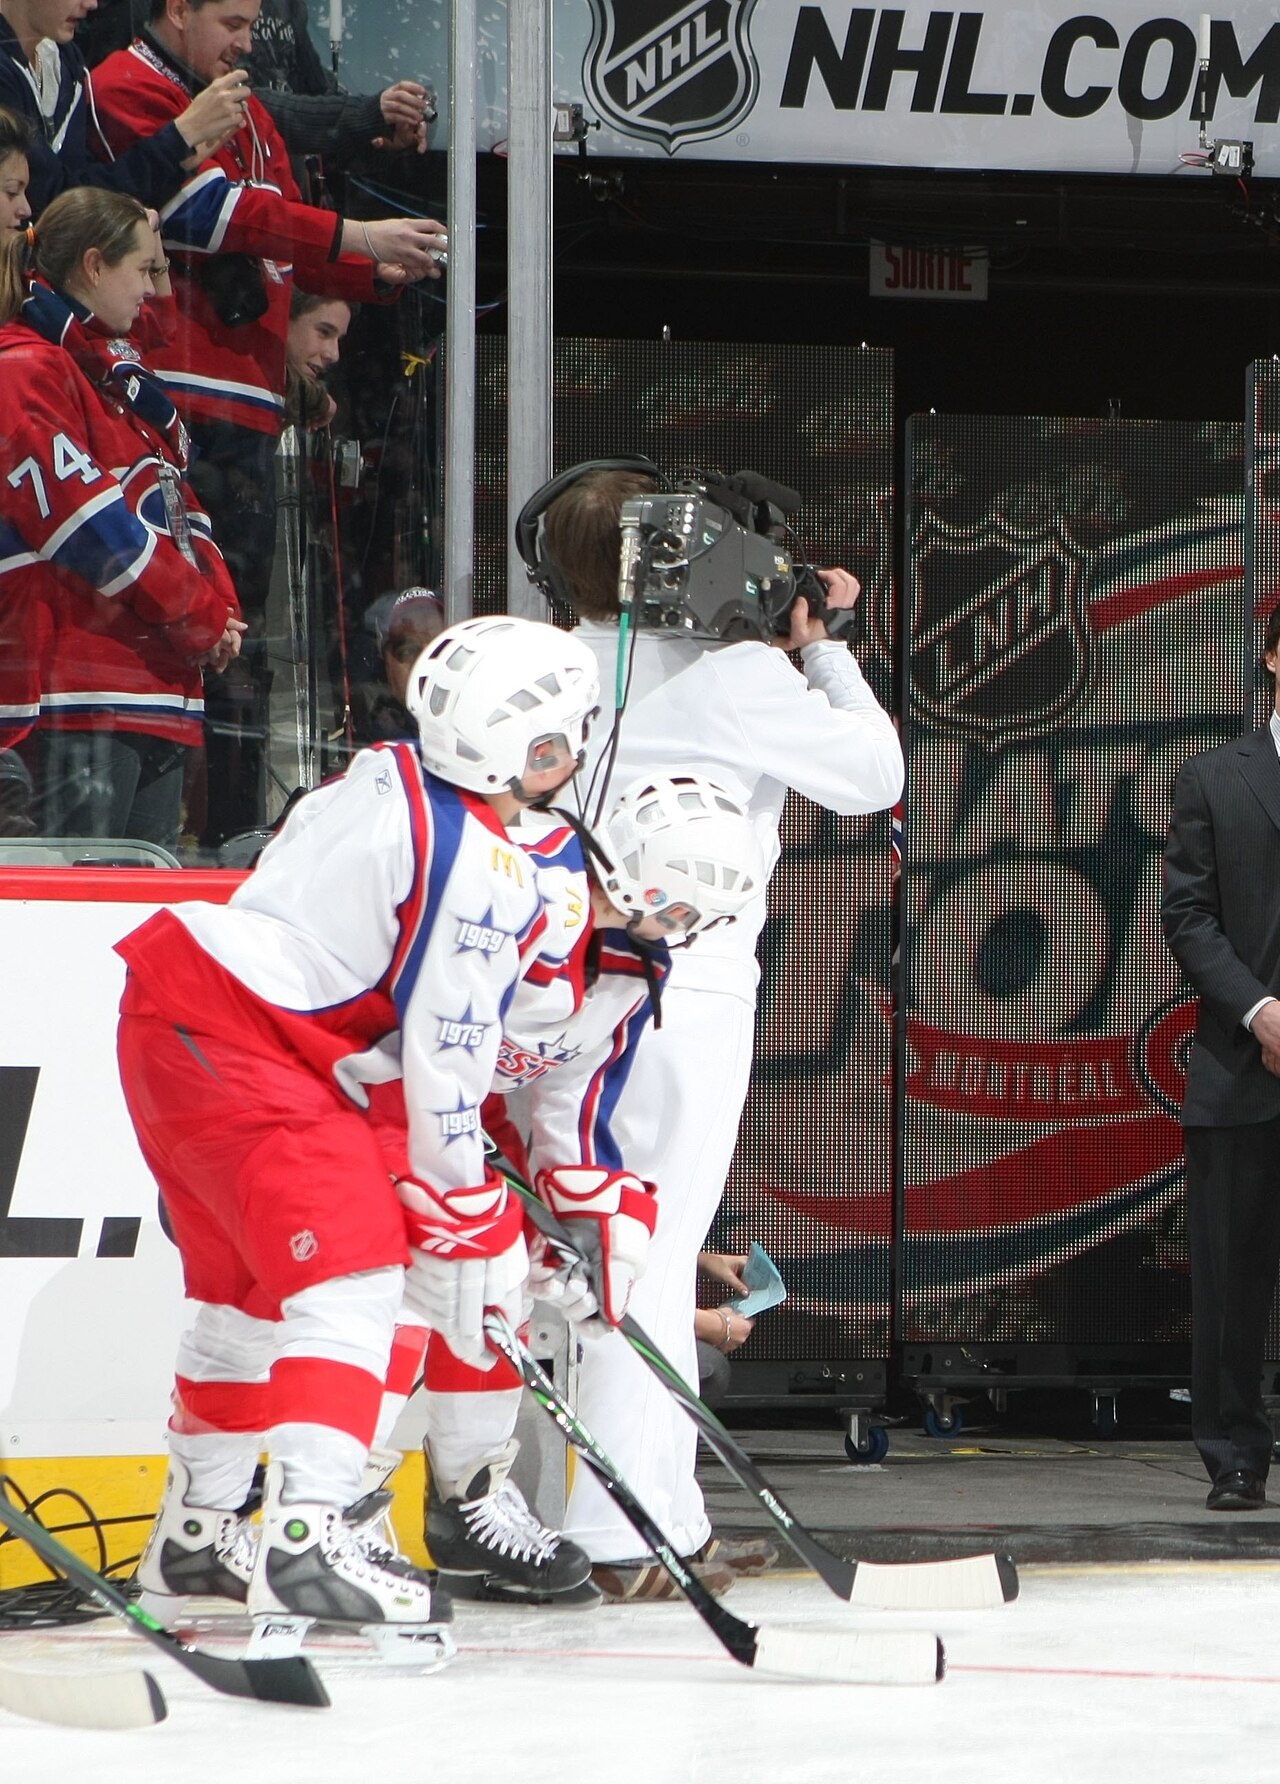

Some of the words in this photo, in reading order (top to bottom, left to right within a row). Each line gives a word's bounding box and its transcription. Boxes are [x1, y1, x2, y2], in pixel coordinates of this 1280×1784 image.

[624, 10, 722, 106] NHL
[884, 245, 973, 292] SORTIE
[7, 432, 103, 519] 74
[936, 564, 1053, 691] LNH
[458, 922, 504, 953] 1969
[439, 1021, 484, 1047] 1975
[442, 1112, 478, 1137] 1993
